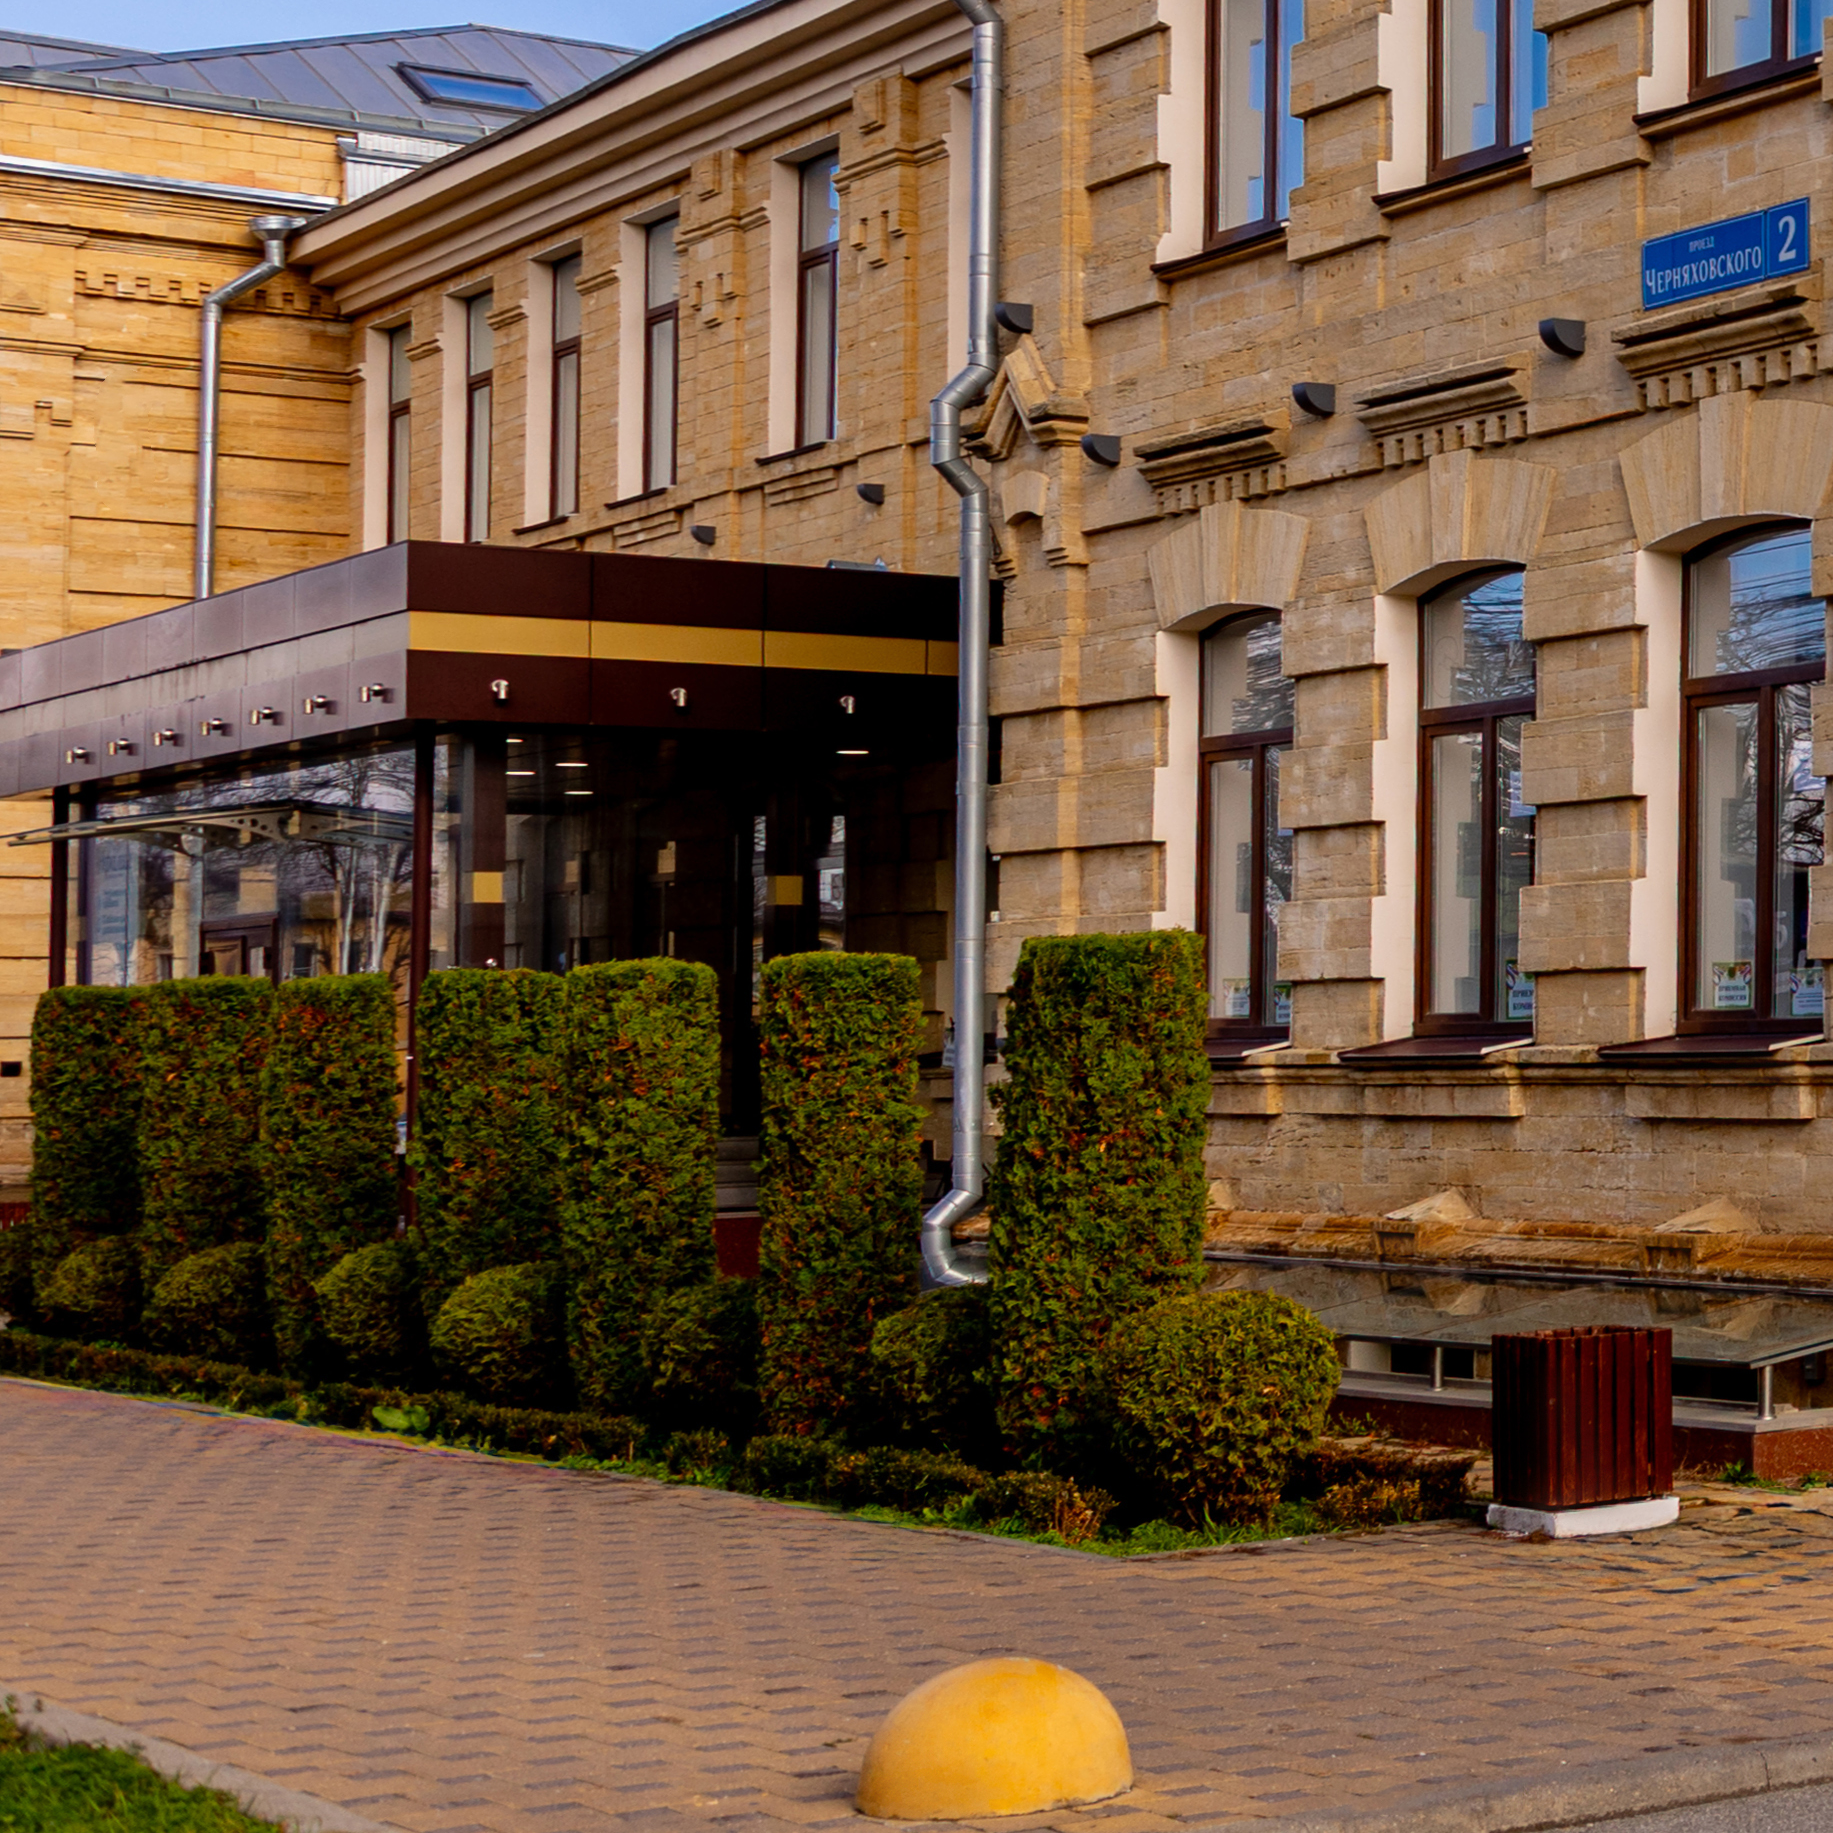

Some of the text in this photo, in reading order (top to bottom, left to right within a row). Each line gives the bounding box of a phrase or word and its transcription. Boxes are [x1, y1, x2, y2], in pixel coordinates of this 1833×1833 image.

[1689, 236, 1715, 253] ПРОЕЗД
[1778, 215, 1796, 263] 2
[1645, 246, 1762, 295] ЧЕРНЯХОВСКОГО
